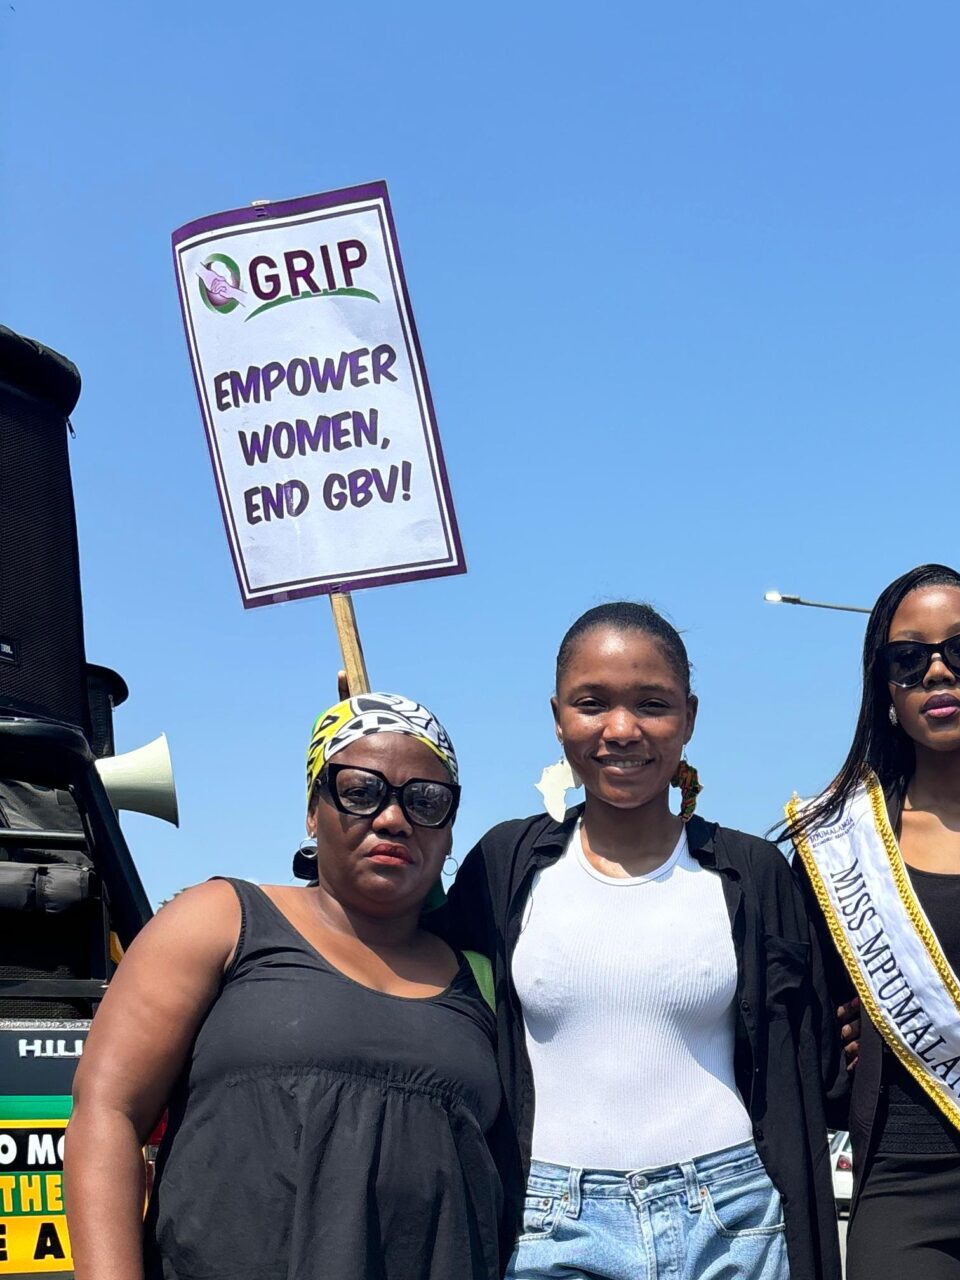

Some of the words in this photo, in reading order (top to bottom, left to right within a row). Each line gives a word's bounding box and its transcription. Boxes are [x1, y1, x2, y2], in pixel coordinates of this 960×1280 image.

[248, 239, 368, 302] GRIP
[213, 343, 399, 412] EMPOWER
[237, 408, 391, 466] WOMEN,
[243, 478, 310, 525] END
[323, 460, 412, 512] GBV!
[830, 856, 878, 932] MISS
[0, 1174, 63, 1213] THE
[33, 1221, 73, 1261] A
